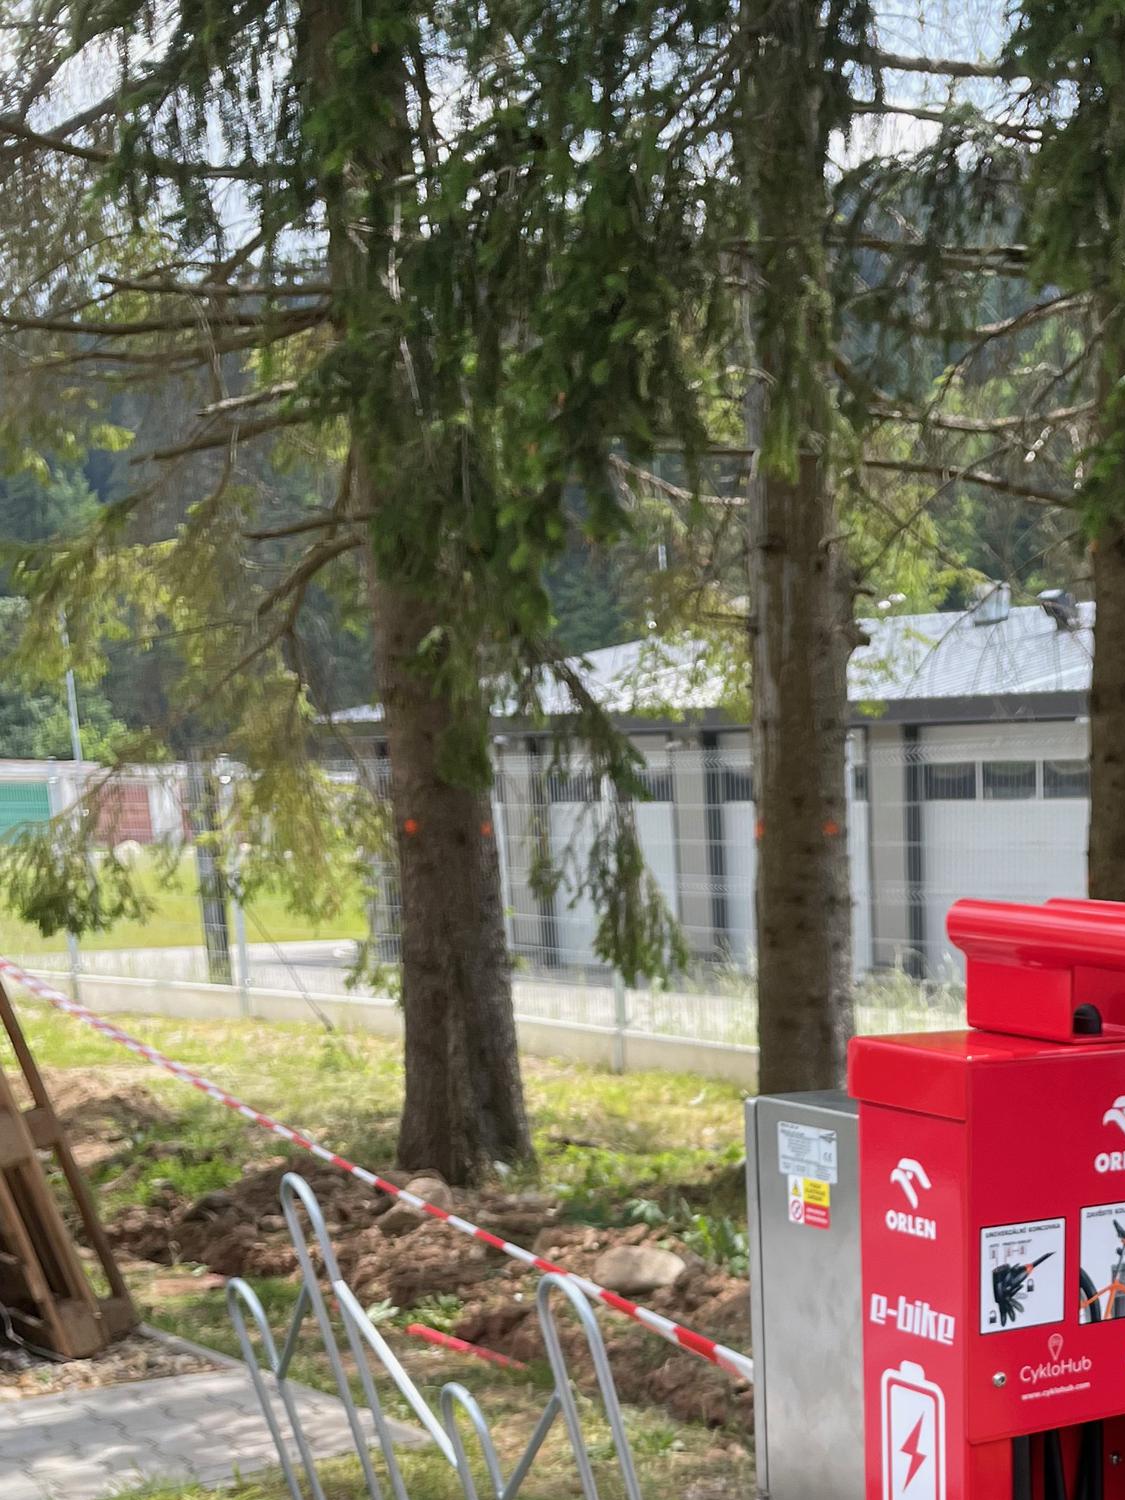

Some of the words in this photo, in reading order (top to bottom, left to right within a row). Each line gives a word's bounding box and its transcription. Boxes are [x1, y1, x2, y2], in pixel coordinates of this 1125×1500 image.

[885, 1209, 937, 1240] ORLEN
[870, 1292, 956, 1346] e-bike
[1020, 1355, 1093, 1385] CykloHub
